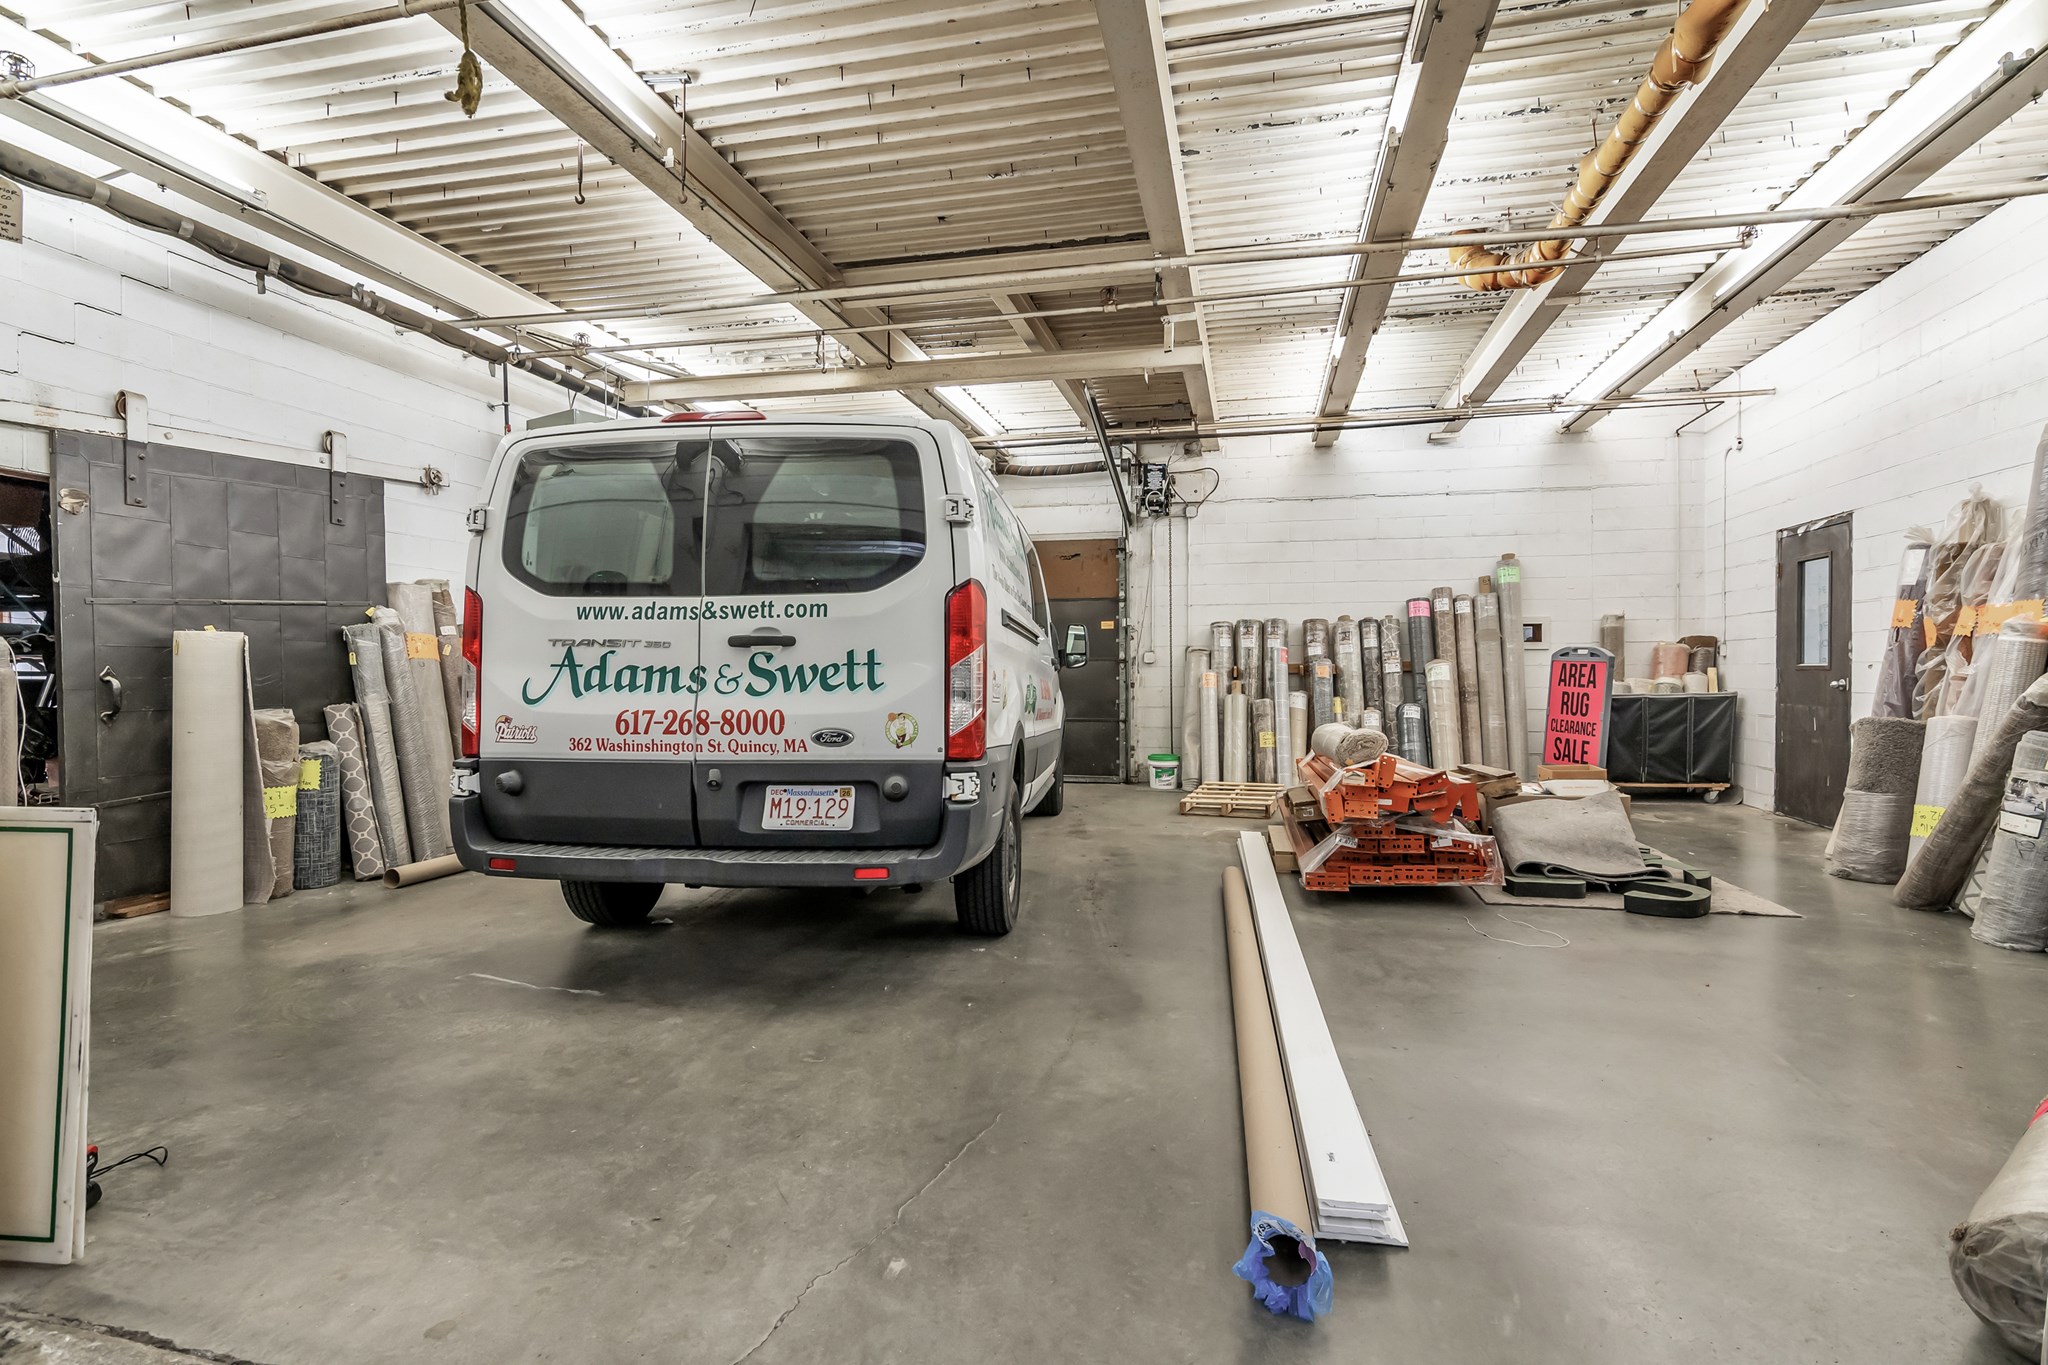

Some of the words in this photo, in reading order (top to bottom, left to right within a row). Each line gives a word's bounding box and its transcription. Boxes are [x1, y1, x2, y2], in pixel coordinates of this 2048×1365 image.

[576, 600, 828, 621] www.adams&swett.com
[548, 638, 642, 648] TRANSIT
[522, 645, 706, 706] Adams
[714, 663, 743, 695] &
[745, 648, 885, 698] Swett
[1557, 662, 1597, 689] AREA
[1560, 691, 1590, 717] RUG
[615, 708, 785, 736] 617-268-8000
[1550, 718, 1597, 737] CLEARANCE
[569, 737, 592, 751] 362
[597, 737, 703, 755] Washinshington
[707, 738, 725, 752] St.
[728, 738, 779, 755] Quincy,
[783, 738, 808, 752] MA
[819, 732, 844, 743] Ford
[1553, 737, 1590, 764] SALE
[787, 788, 834, 796] Massachusetts
[785, 819, 830, 827] COMMERCIAL
